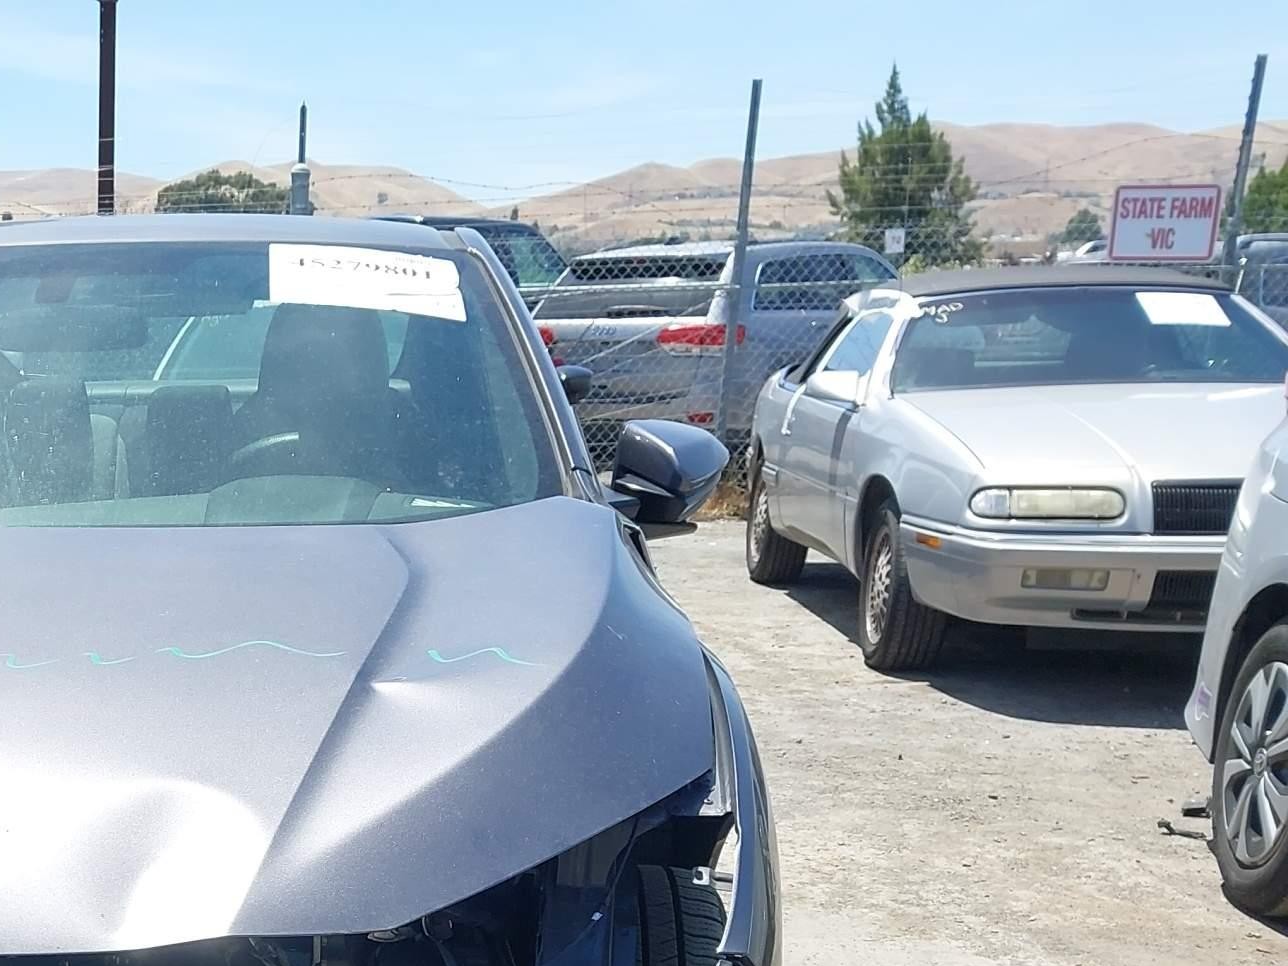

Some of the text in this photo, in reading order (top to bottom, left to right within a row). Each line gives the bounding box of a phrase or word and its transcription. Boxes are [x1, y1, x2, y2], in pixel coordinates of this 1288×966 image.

[1119, 196, 1215, 219] STATE FARM
[1150, 228, 1176, 249] VIC
